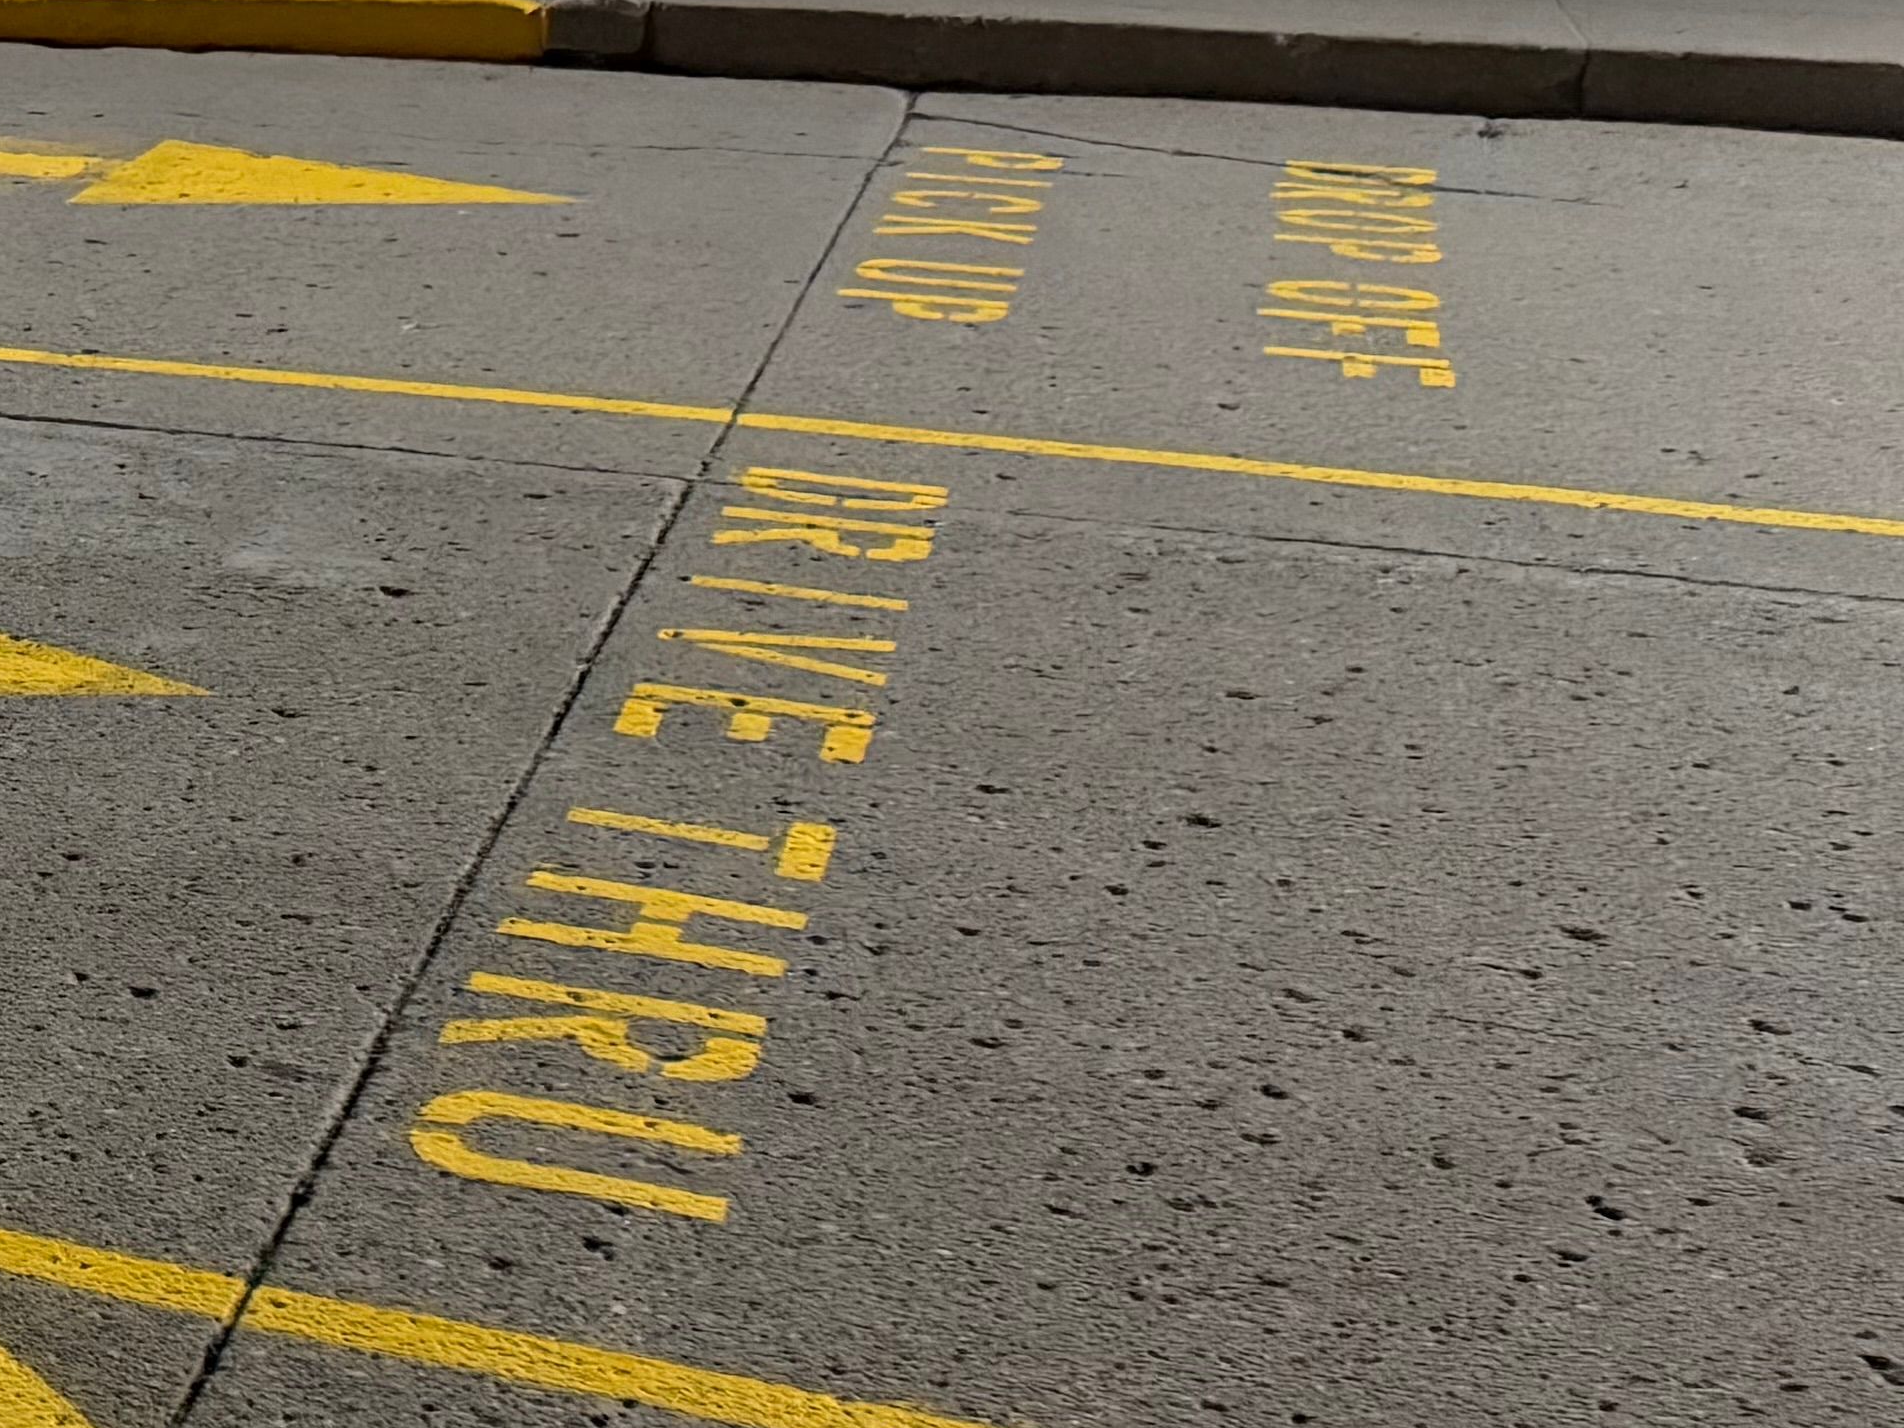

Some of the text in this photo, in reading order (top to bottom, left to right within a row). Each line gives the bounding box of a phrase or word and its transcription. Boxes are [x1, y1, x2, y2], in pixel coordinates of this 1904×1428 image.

[837, 147, 1065, 323] PICK UP
[1257, 161, 1456, 388] DROP OFF
[408, 467, 949, 1223] DRIVE THRU
